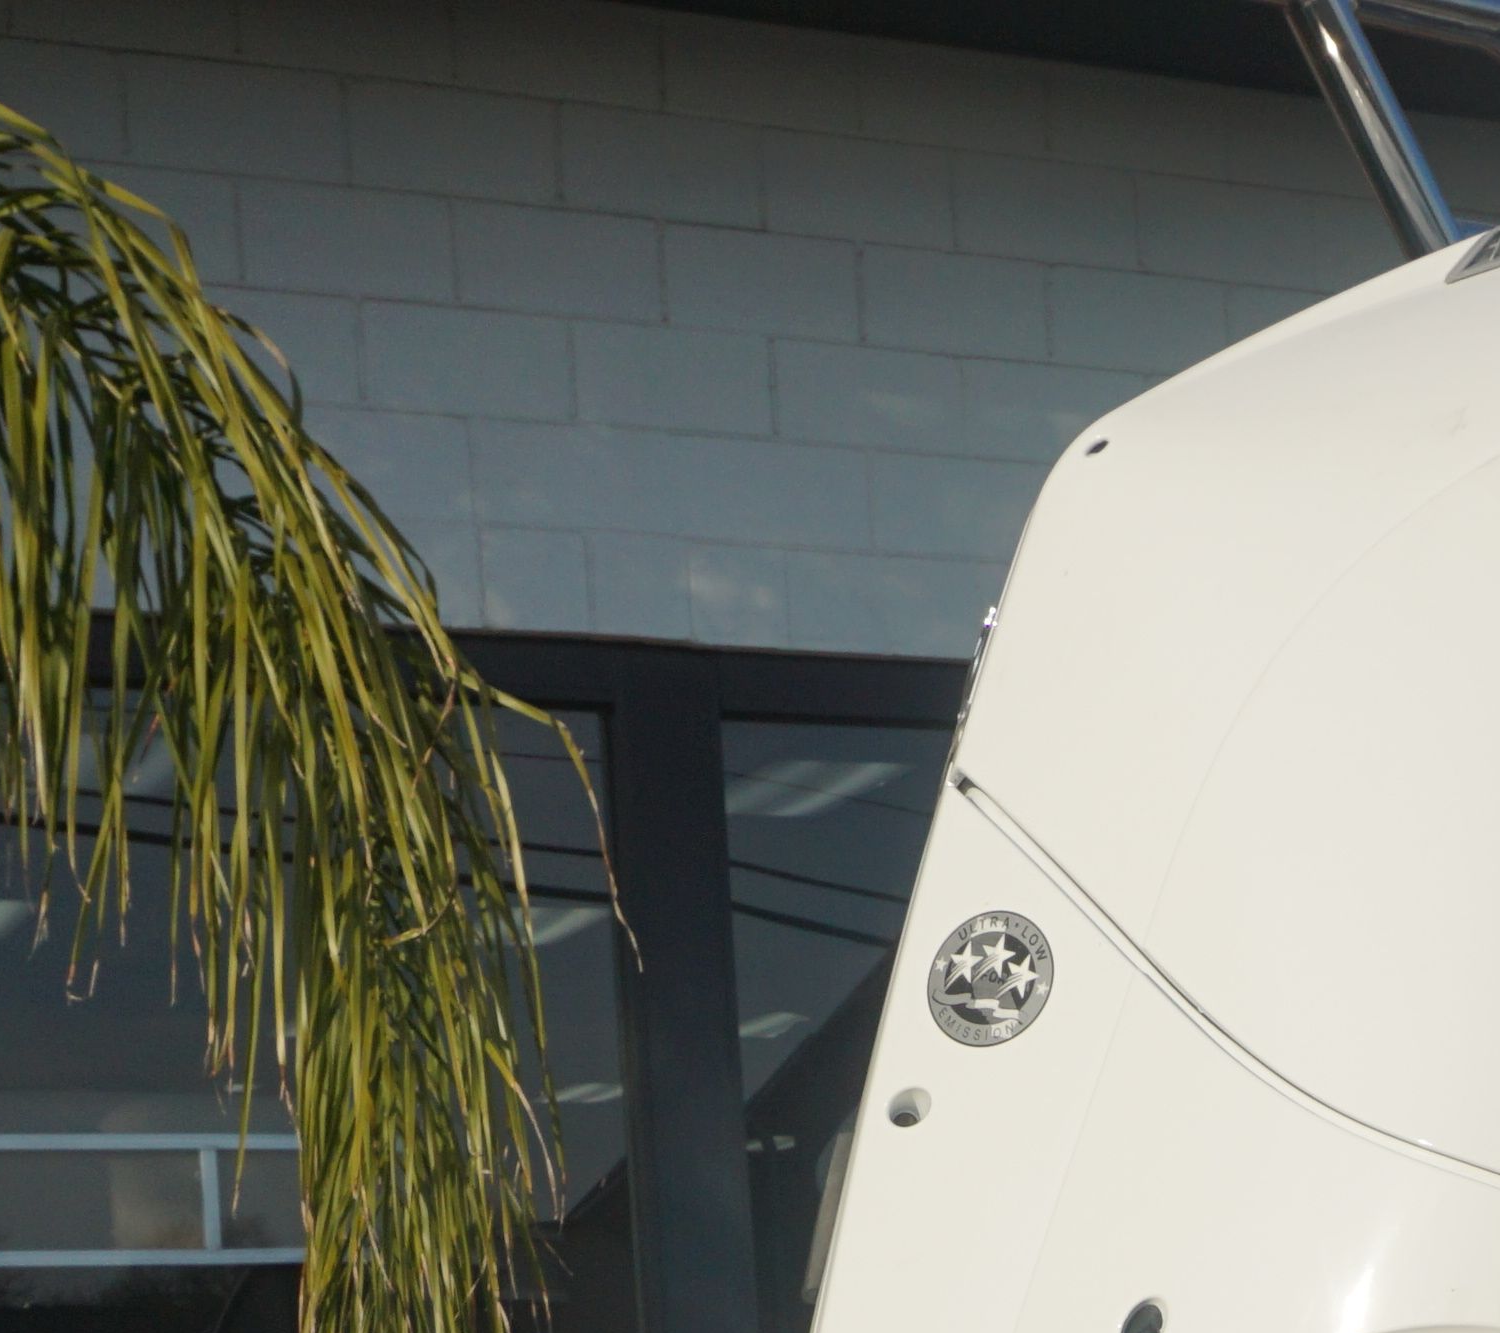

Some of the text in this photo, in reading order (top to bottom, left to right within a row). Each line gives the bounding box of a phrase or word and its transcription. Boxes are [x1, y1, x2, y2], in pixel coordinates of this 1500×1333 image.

[957, 915, 1049, 962] ULTRA LOW
[937, 1005, 1016, 1041] EMISSION
